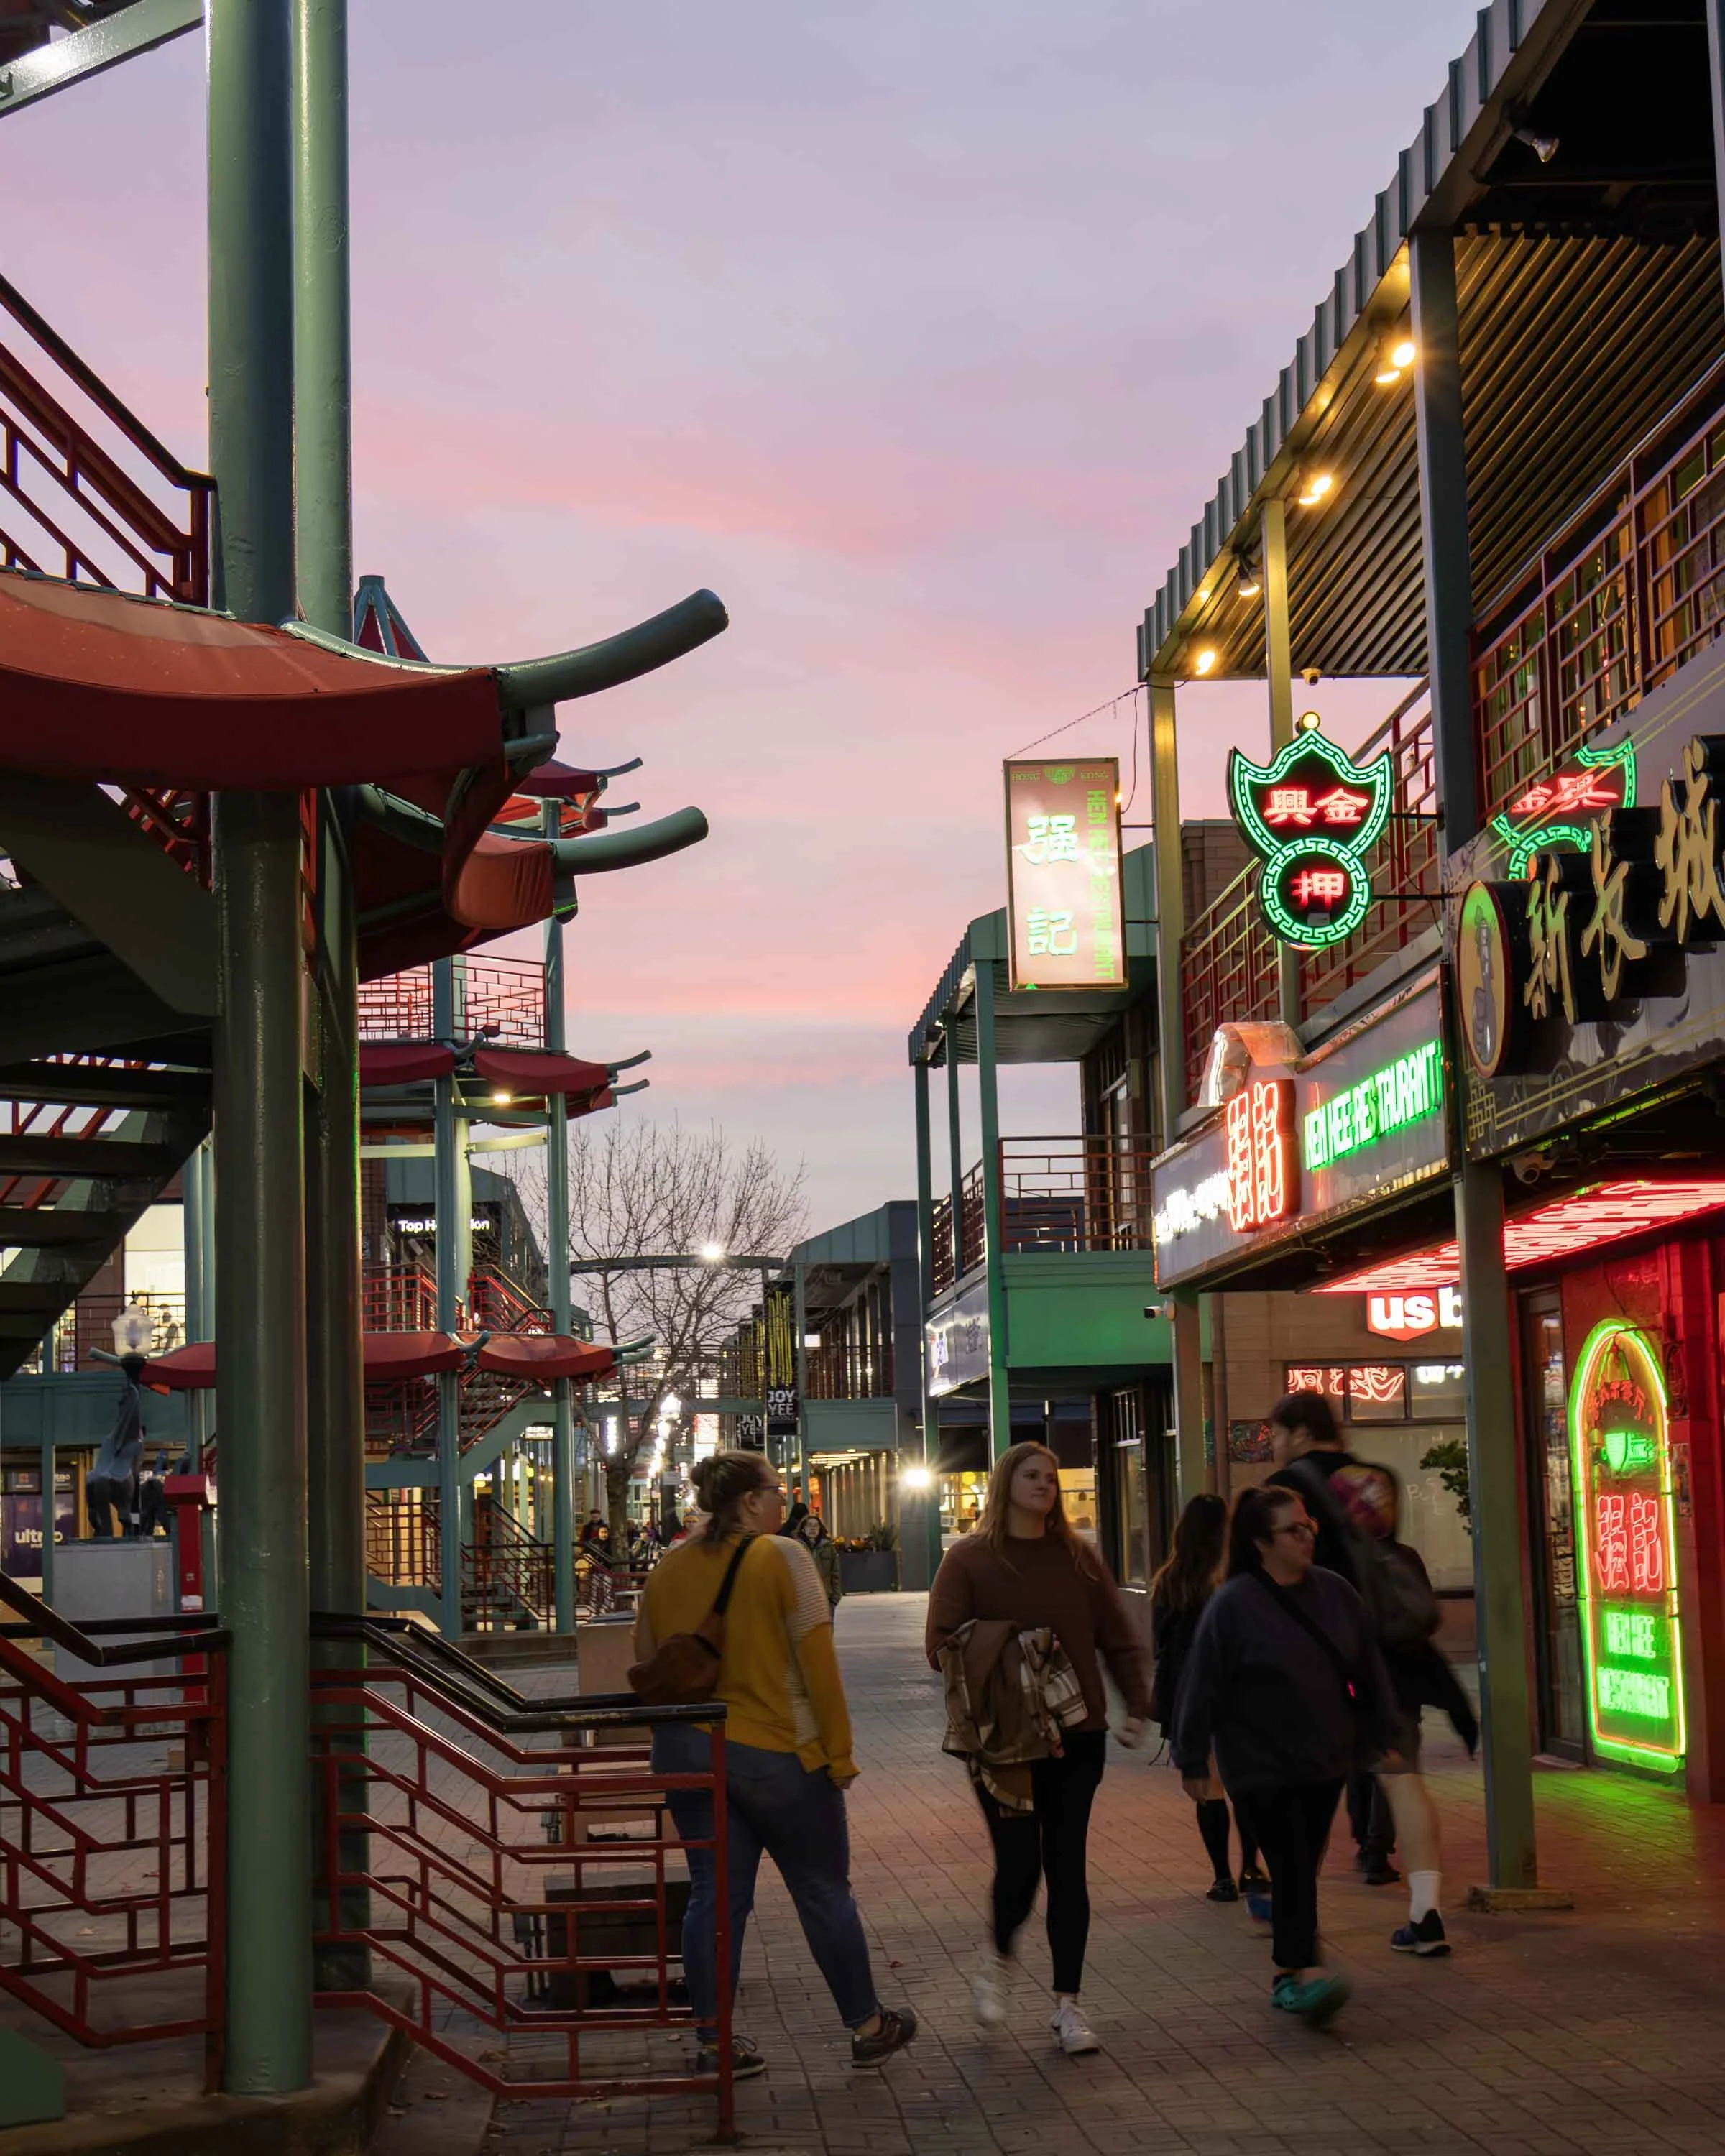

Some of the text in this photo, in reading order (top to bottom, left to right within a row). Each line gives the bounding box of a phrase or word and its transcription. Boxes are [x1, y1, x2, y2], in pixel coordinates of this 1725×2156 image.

[1291, 870, 1345, 911] 押
[398, 1220, 424, 1234] Top
[768, 1389, 796, 1403] JOY
[768, 1403, 794, 1416] YEE
